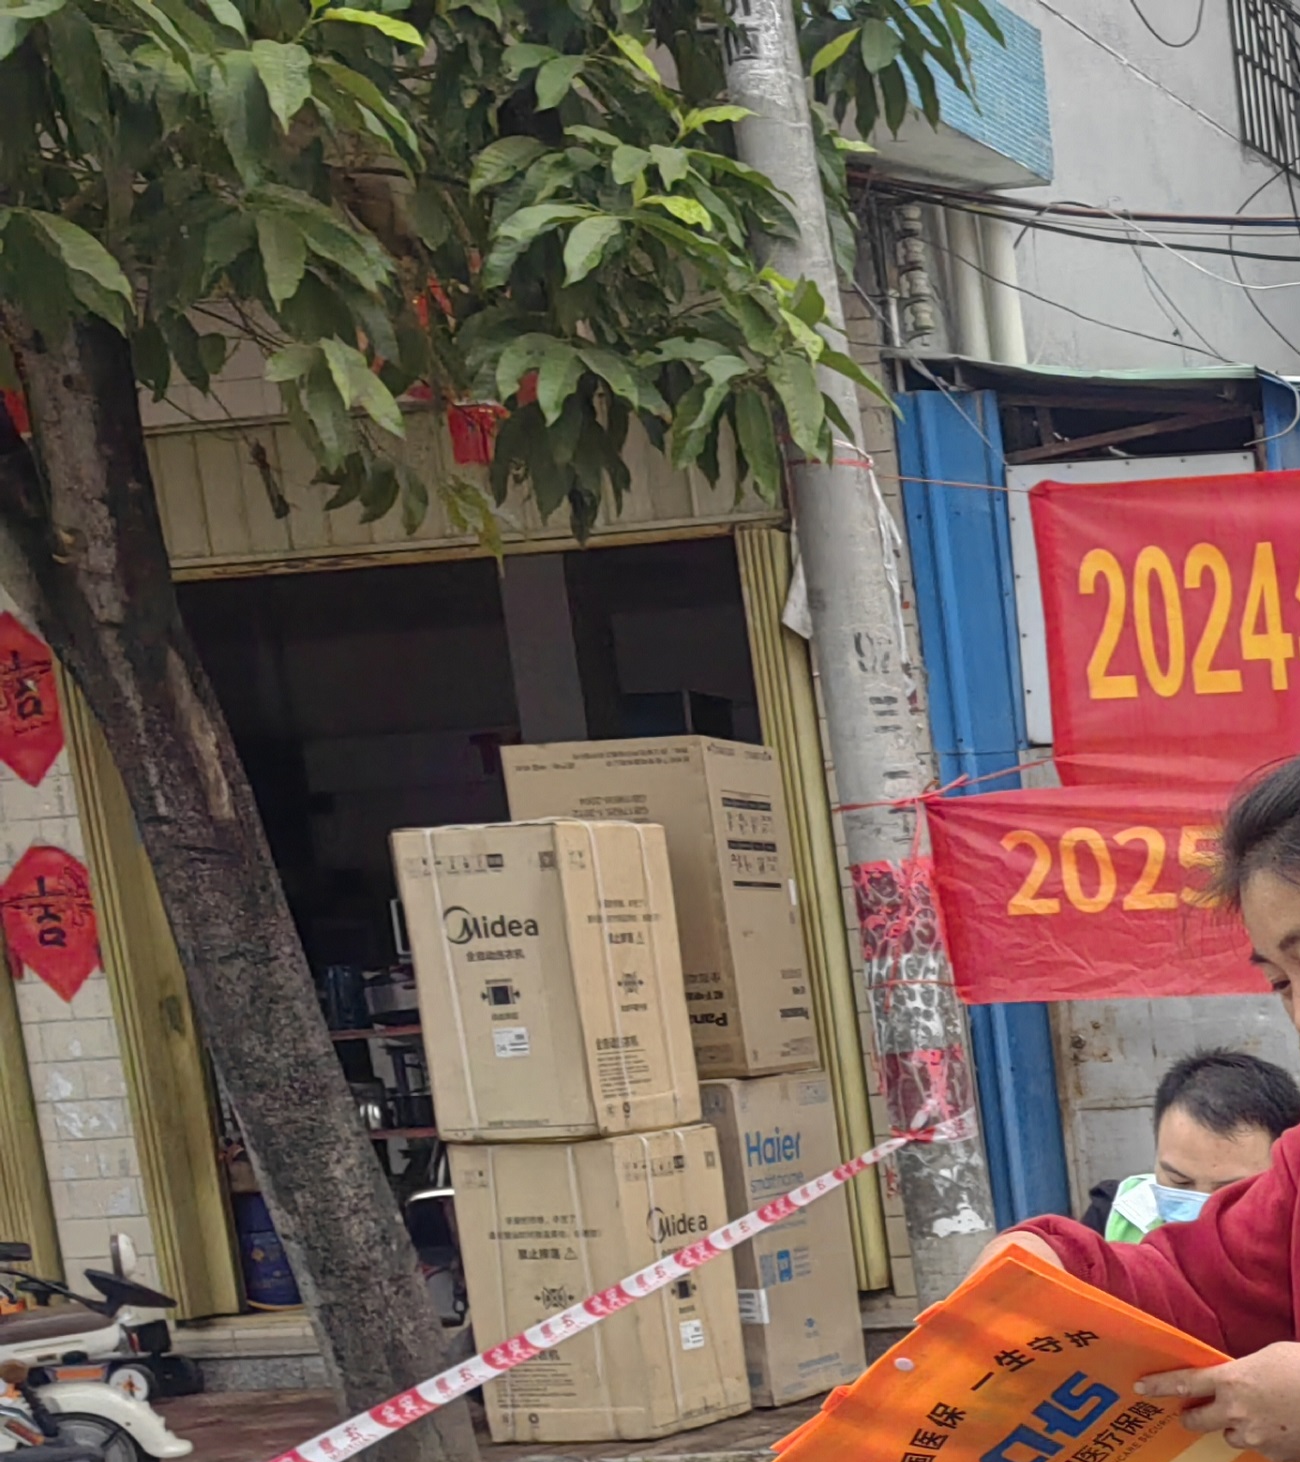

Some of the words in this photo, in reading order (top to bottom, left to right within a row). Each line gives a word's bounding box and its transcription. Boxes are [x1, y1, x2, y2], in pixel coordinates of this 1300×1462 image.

[443, 906, 539, 944] Midea
[745, 1126, 801, 1168] Haier
[647, 1207, 708, 1244] Midea
[970, 1329, 1100, 1391] 一生守护
